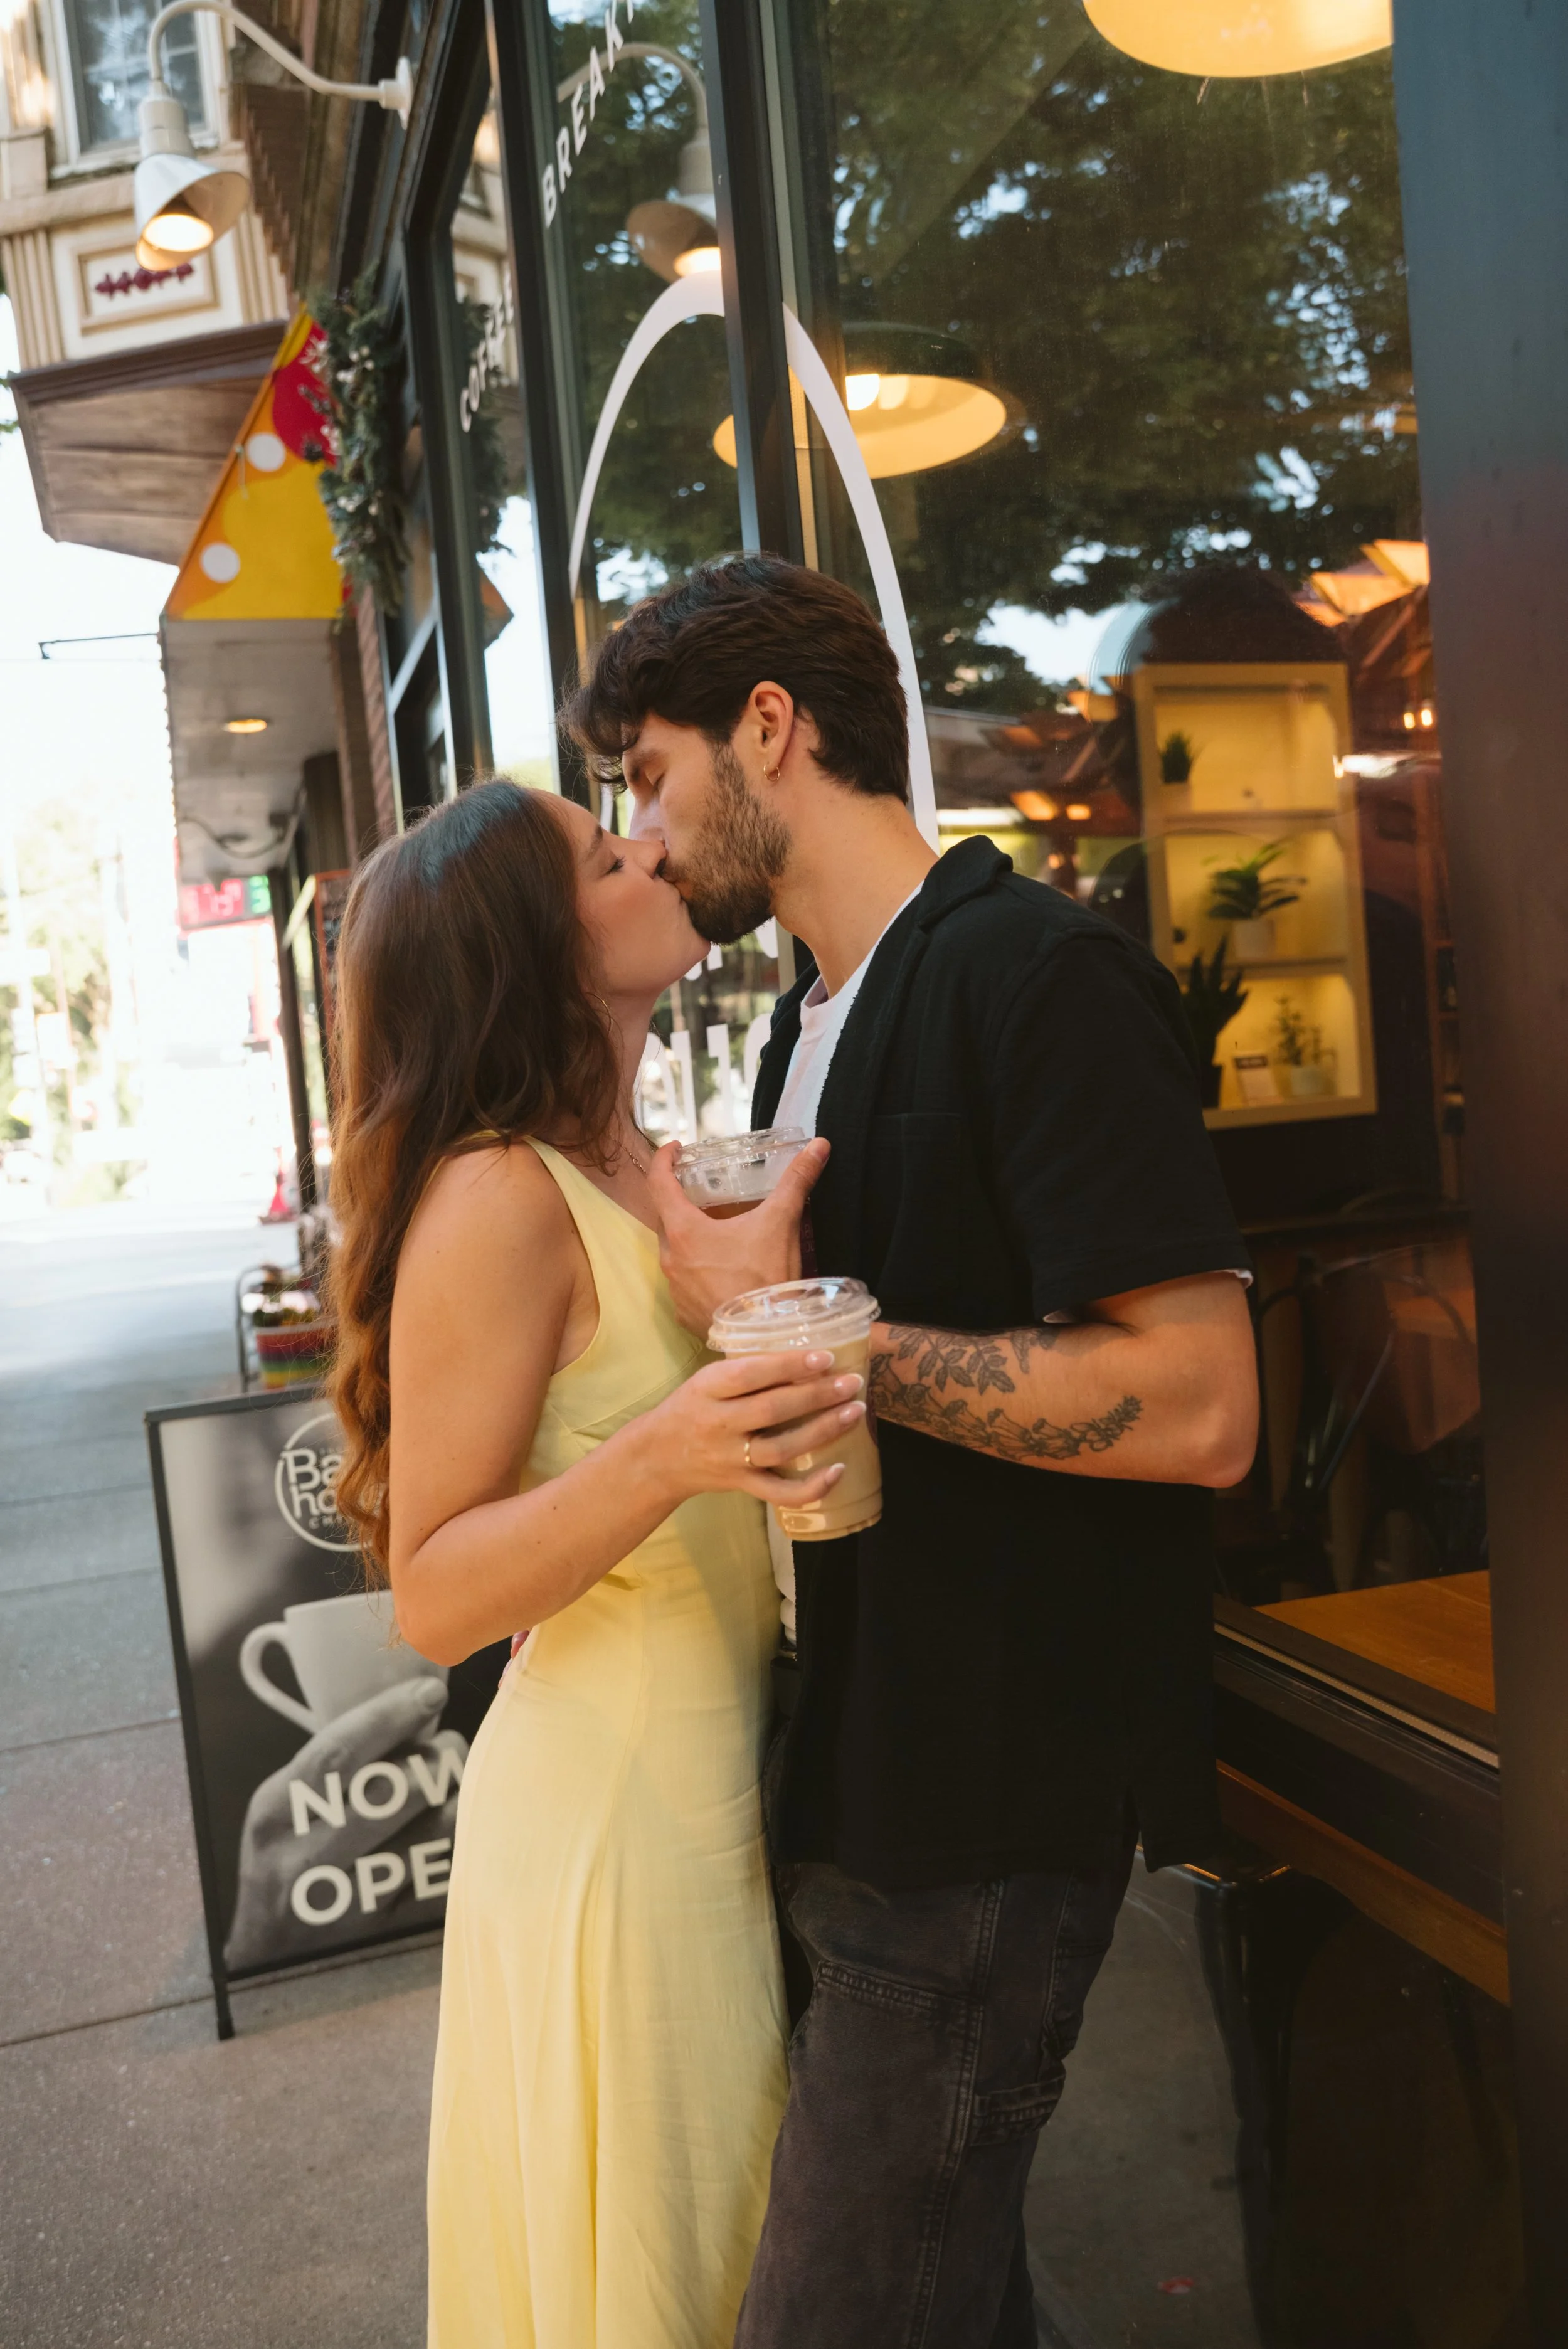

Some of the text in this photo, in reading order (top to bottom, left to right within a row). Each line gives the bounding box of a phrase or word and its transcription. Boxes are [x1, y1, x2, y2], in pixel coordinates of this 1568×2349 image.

[280, 1448, 343, 1492] Ba
[289, 1484, 337, 1519] ho
[289, 1747, 466, 1837] NOW
[290, 1837, 453, 1926] OPE
